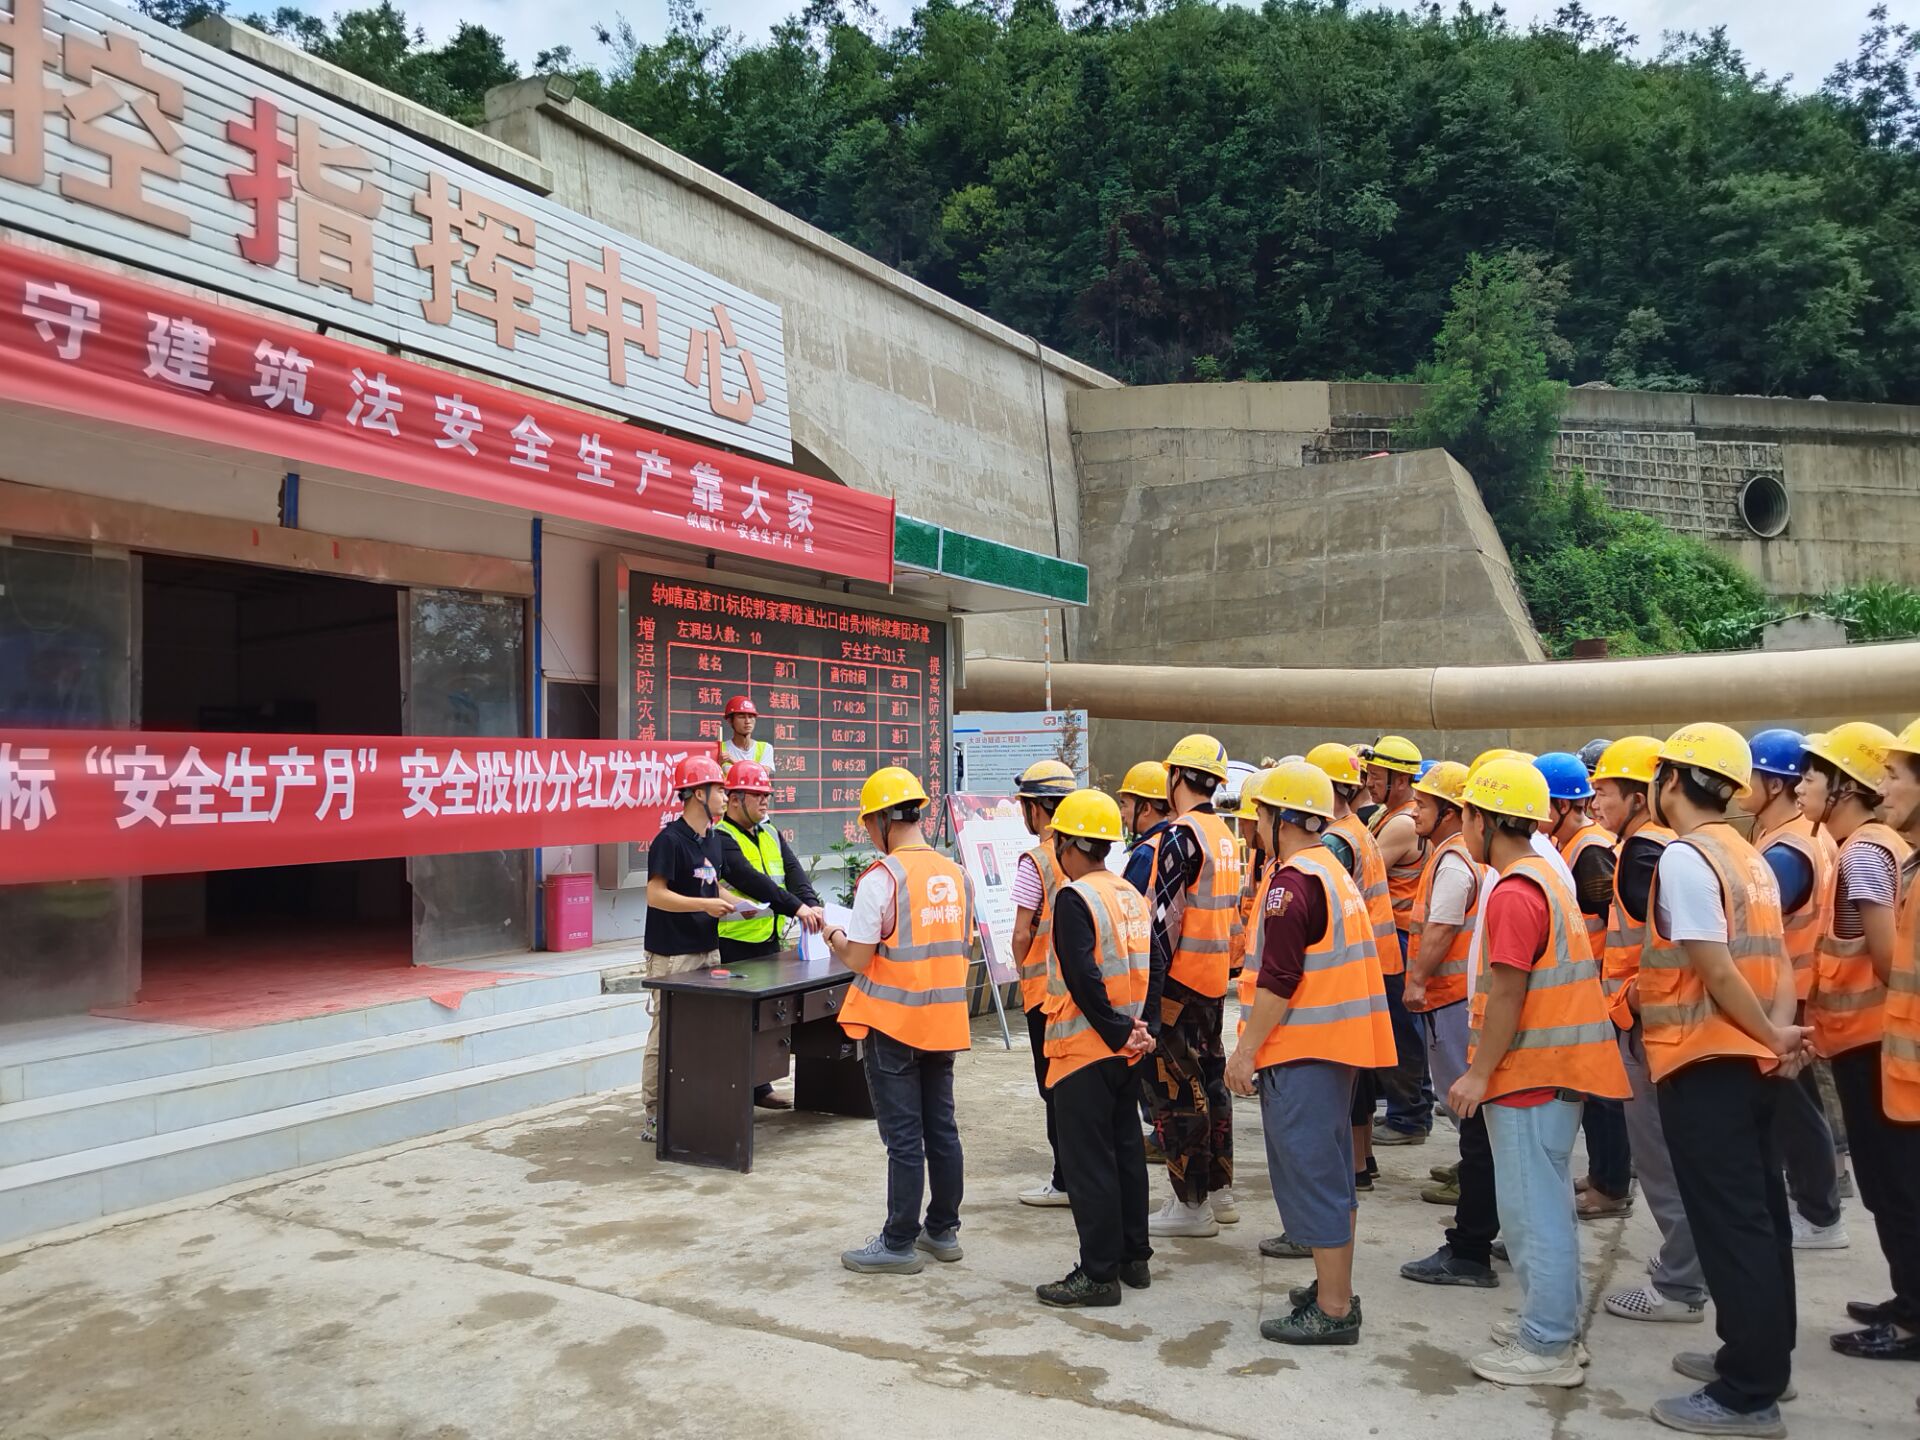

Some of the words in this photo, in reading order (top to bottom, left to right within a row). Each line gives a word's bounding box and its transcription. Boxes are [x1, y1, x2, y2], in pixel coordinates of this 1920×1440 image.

[751, 632, 762, 645] 10
[841, 641, 906, 665] 安全生产311天
[698, 653, 723, 672] 姓名
[774, 661, 796, 679] 部门
[830, 666, 867, 685] 通行时间
[891, 673, 908, 689] 左洞
